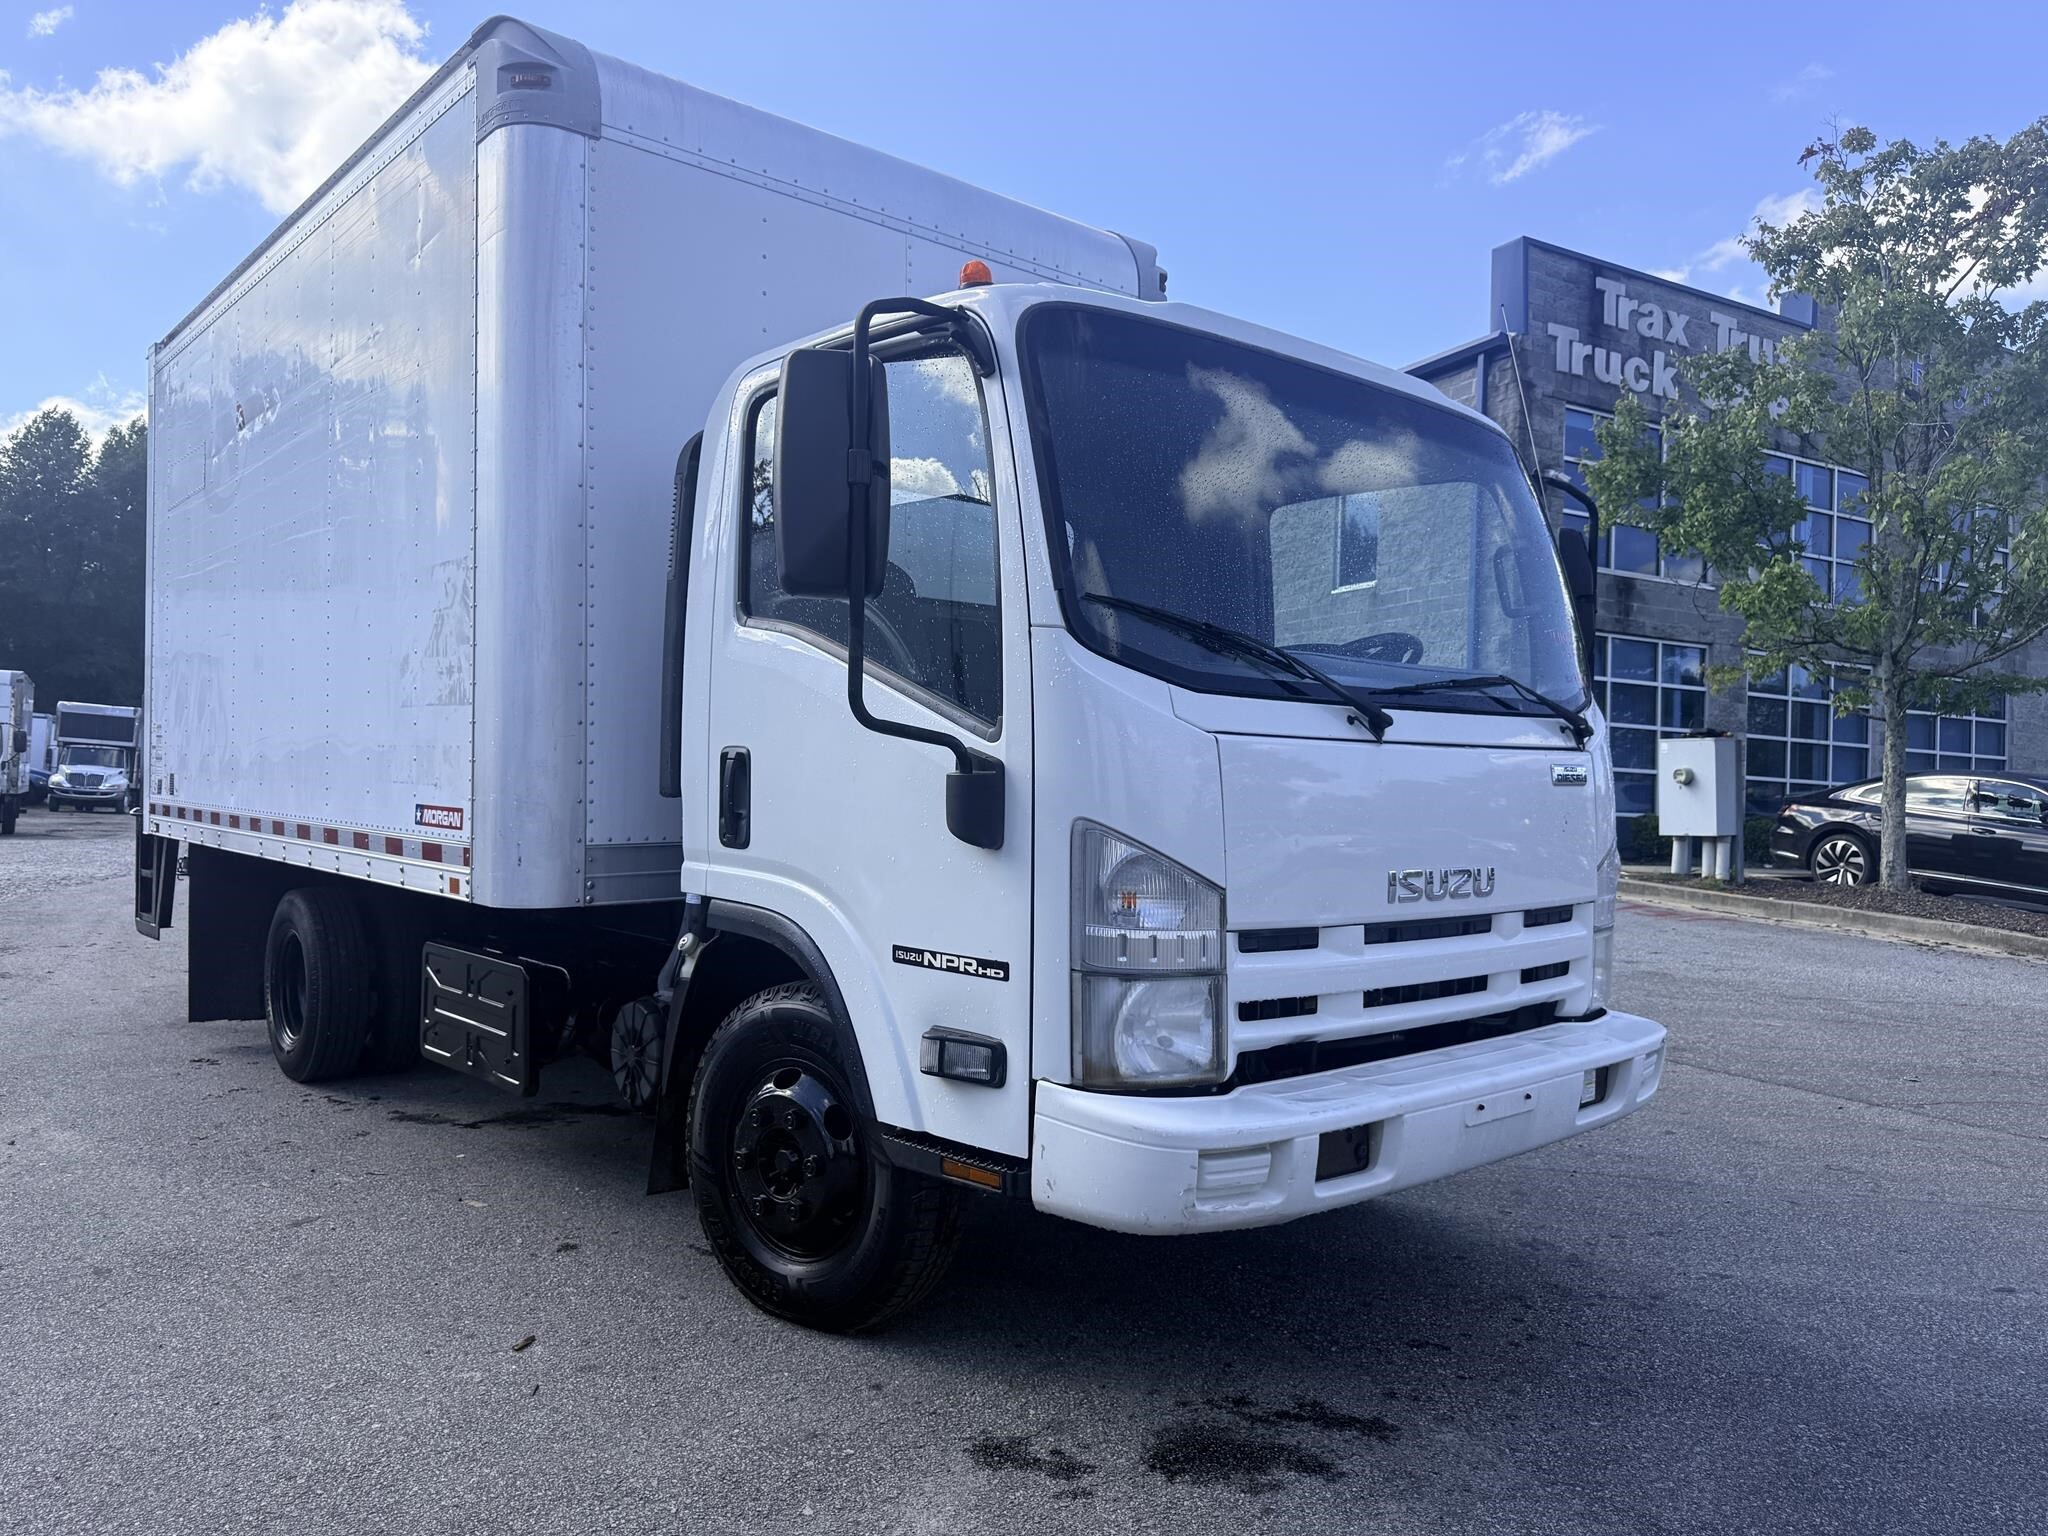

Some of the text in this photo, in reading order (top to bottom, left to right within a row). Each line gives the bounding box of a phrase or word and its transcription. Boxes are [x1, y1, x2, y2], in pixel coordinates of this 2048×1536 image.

[1596, 276, 1689, 348] Trax
[1547, 322, 1679, 400] Truck
[423, 808, 461, 827] MORGAN
[1387, 866, 1495, 904] ISUZU
[896, 950, 922, 961] ISUZU
